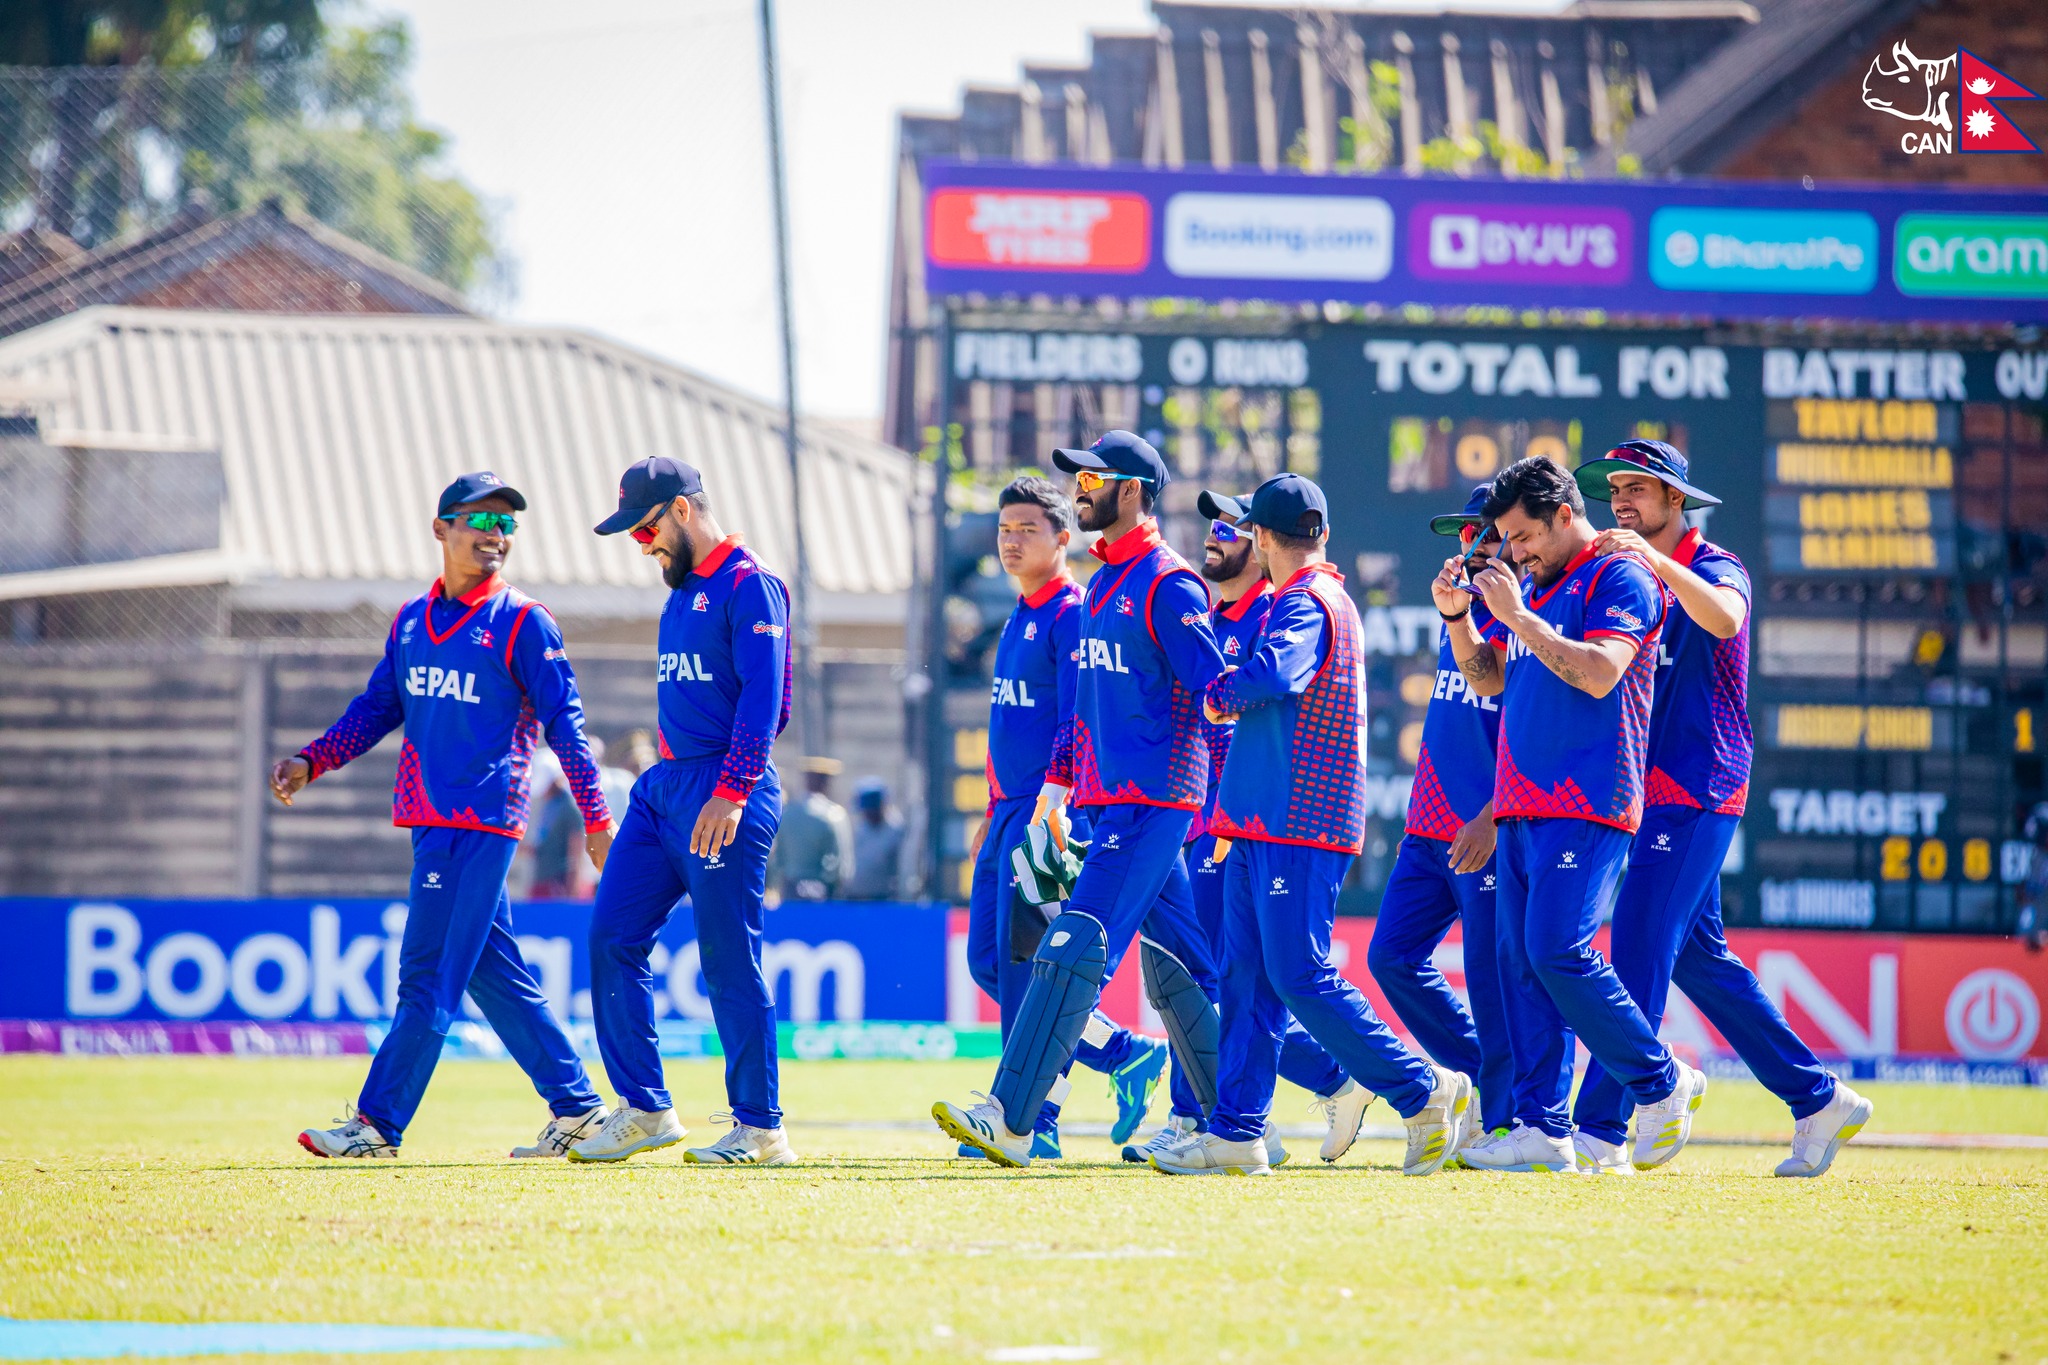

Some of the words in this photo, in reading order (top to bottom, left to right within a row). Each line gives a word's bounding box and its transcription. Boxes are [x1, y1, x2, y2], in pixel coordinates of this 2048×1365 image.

[984, 234, 1092, 265] TYRES
[1187, 217, 1378, 253] Booking.com
[1481, 220, 1618, 269] BYJU'S
[1703, 233, 1865, 271] BharatPe
[954, 333, 1142, 382] FIELDERS
[1214, 339, 1308, 388] RUNS
[1363, 340, 1602, 398] TOTAL
[1618, 345, 1730, 400] FOR
[1762, 348, 1968, 399] BATTER
[1795, 398, 1938, 442] TAYLOR
[658, 653, 713, 682] EPAL
[1079, 638, 1130, 674] EPAL
[991, 677, 1035, 707] EPAL
[1769, 788, 1948, 836] TARGET
[704, 862, 726, 870] KELME
[1651, 844, 1672, 852] KELME
[67, 903, 864, 1021] Booki.m
